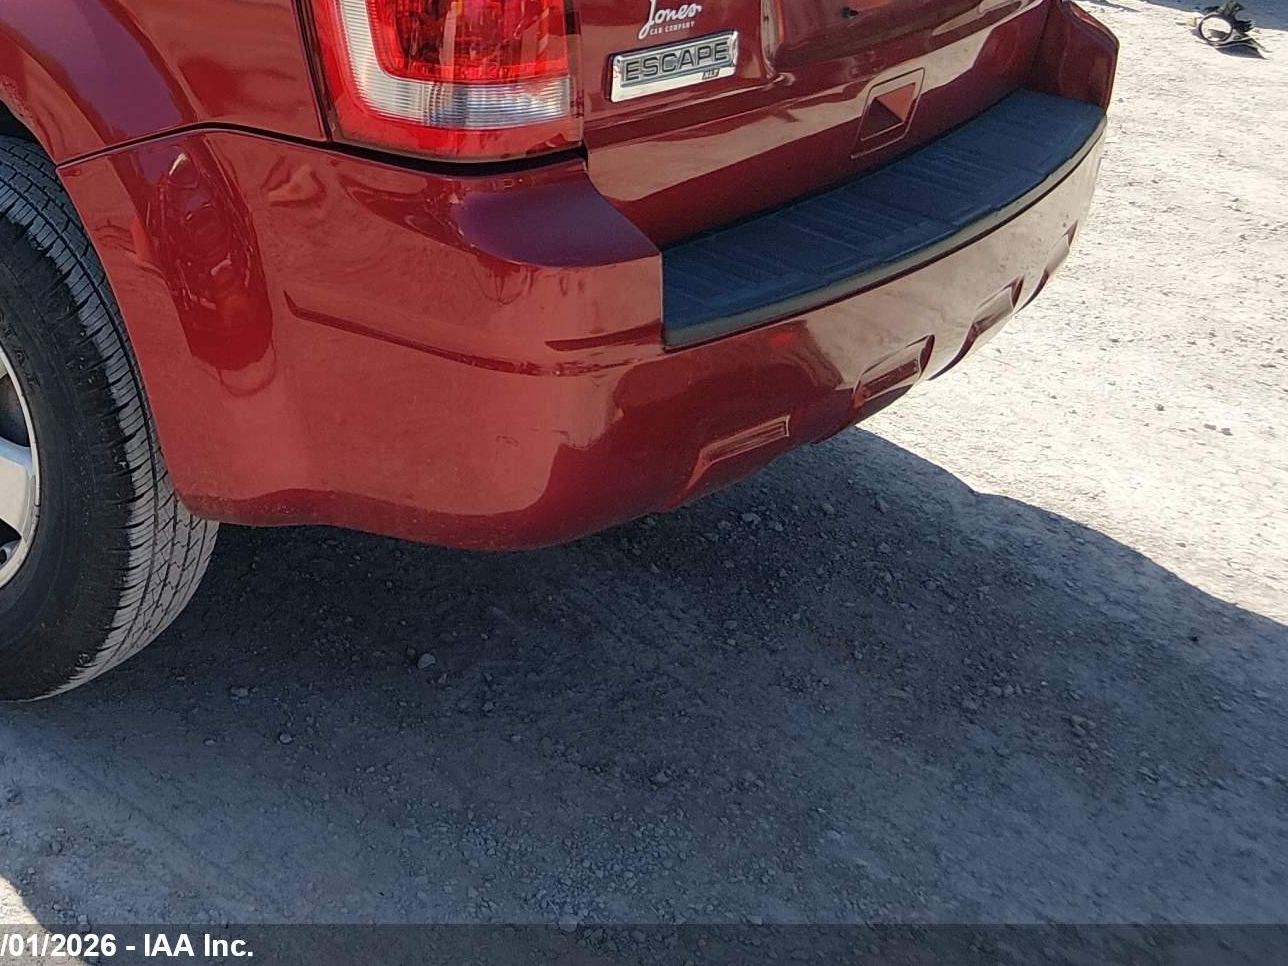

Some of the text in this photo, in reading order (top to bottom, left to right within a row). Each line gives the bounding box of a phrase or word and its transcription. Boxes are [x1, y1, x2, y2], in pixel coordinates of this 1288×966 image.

[649, 21, 696, 36] CAR COMPANY
[624, 41, 728, 82] ESCAPE
